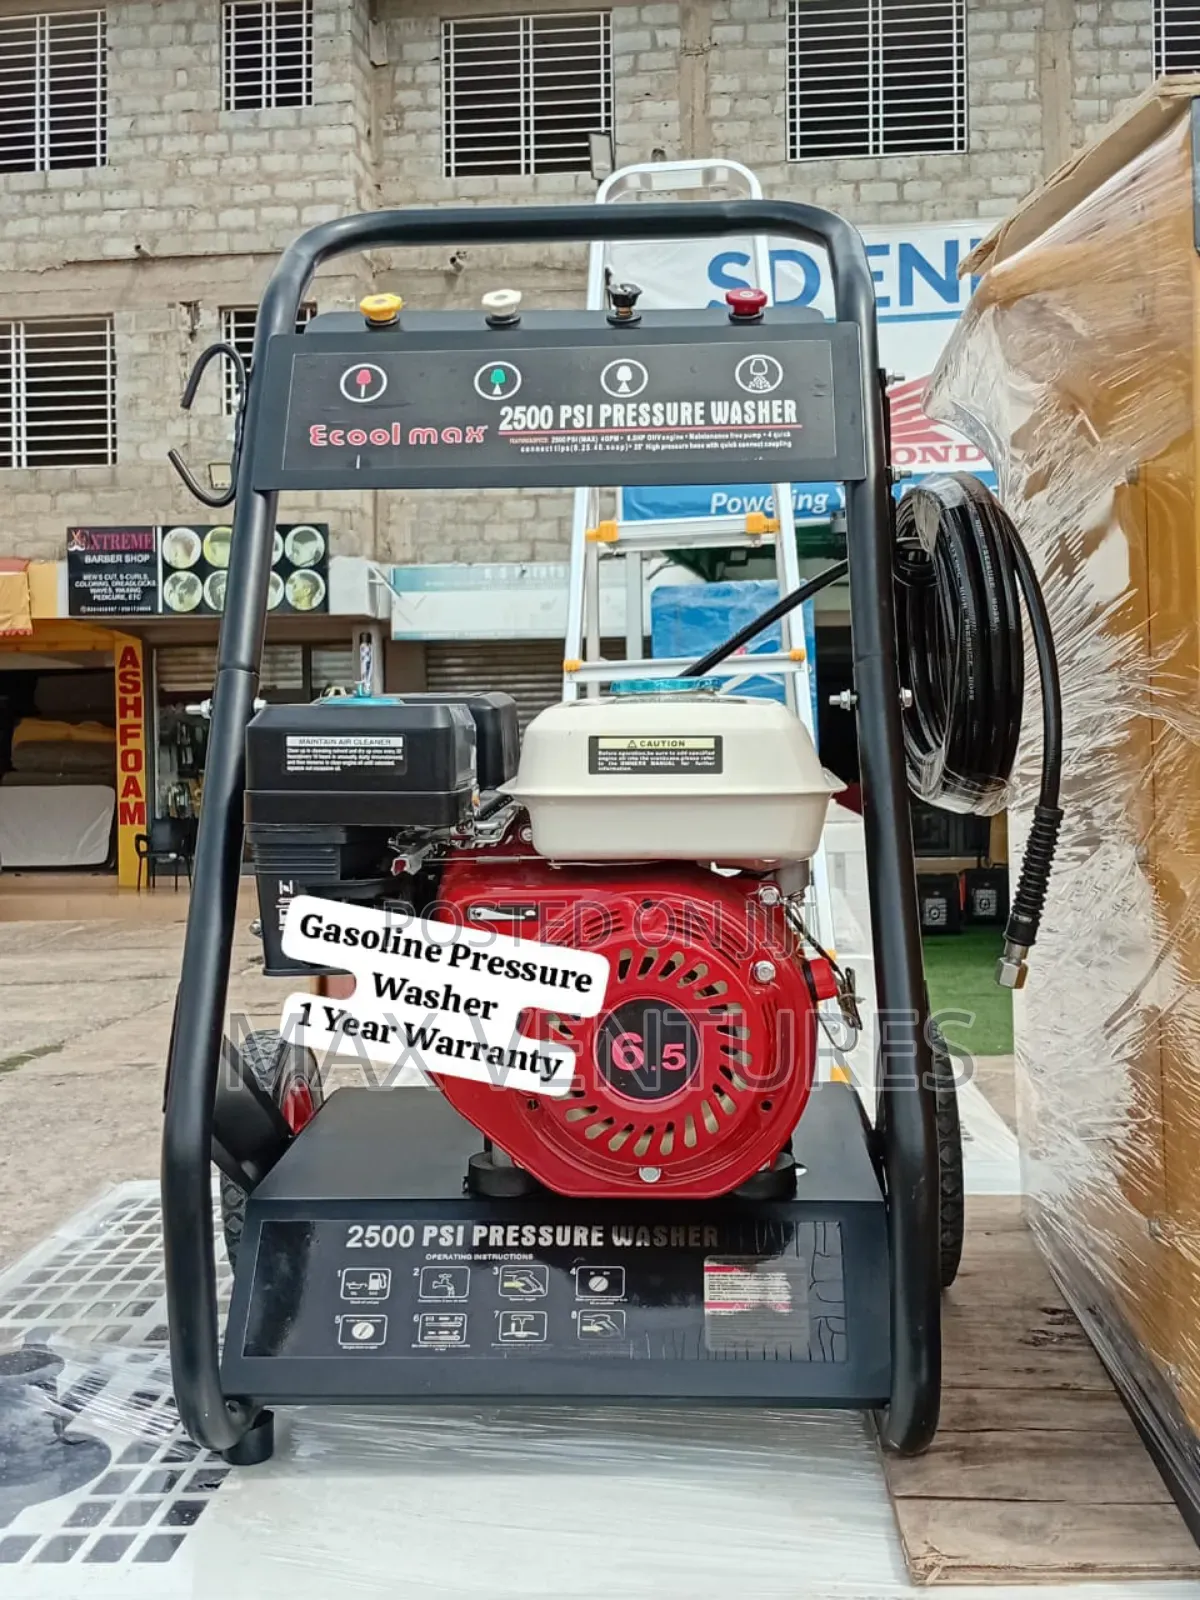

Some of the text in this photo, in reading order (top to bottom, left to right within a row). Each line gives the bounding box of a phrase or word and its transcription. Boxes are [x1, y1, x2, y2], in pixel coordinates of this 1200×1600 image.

[499, 399, 798, 431] 2500 PSI PRESSURE WASHER
[309, 421, 489, 447] Ecool max
[711, 489, 829, 514] Poweing
[84, 553, 150, 564] BARBER SHOP
[118, 645, 147, 826] ASHFOAM
[299, 738, 391, 746] MAINTAIN AIR CLEANER
[610, 1031, 687, 1072] 6.5
[346, 1224, 719, 1248] 2500 PSI PRESSURE WASHER
[425, 1253, 472, 1261] OPERATING
